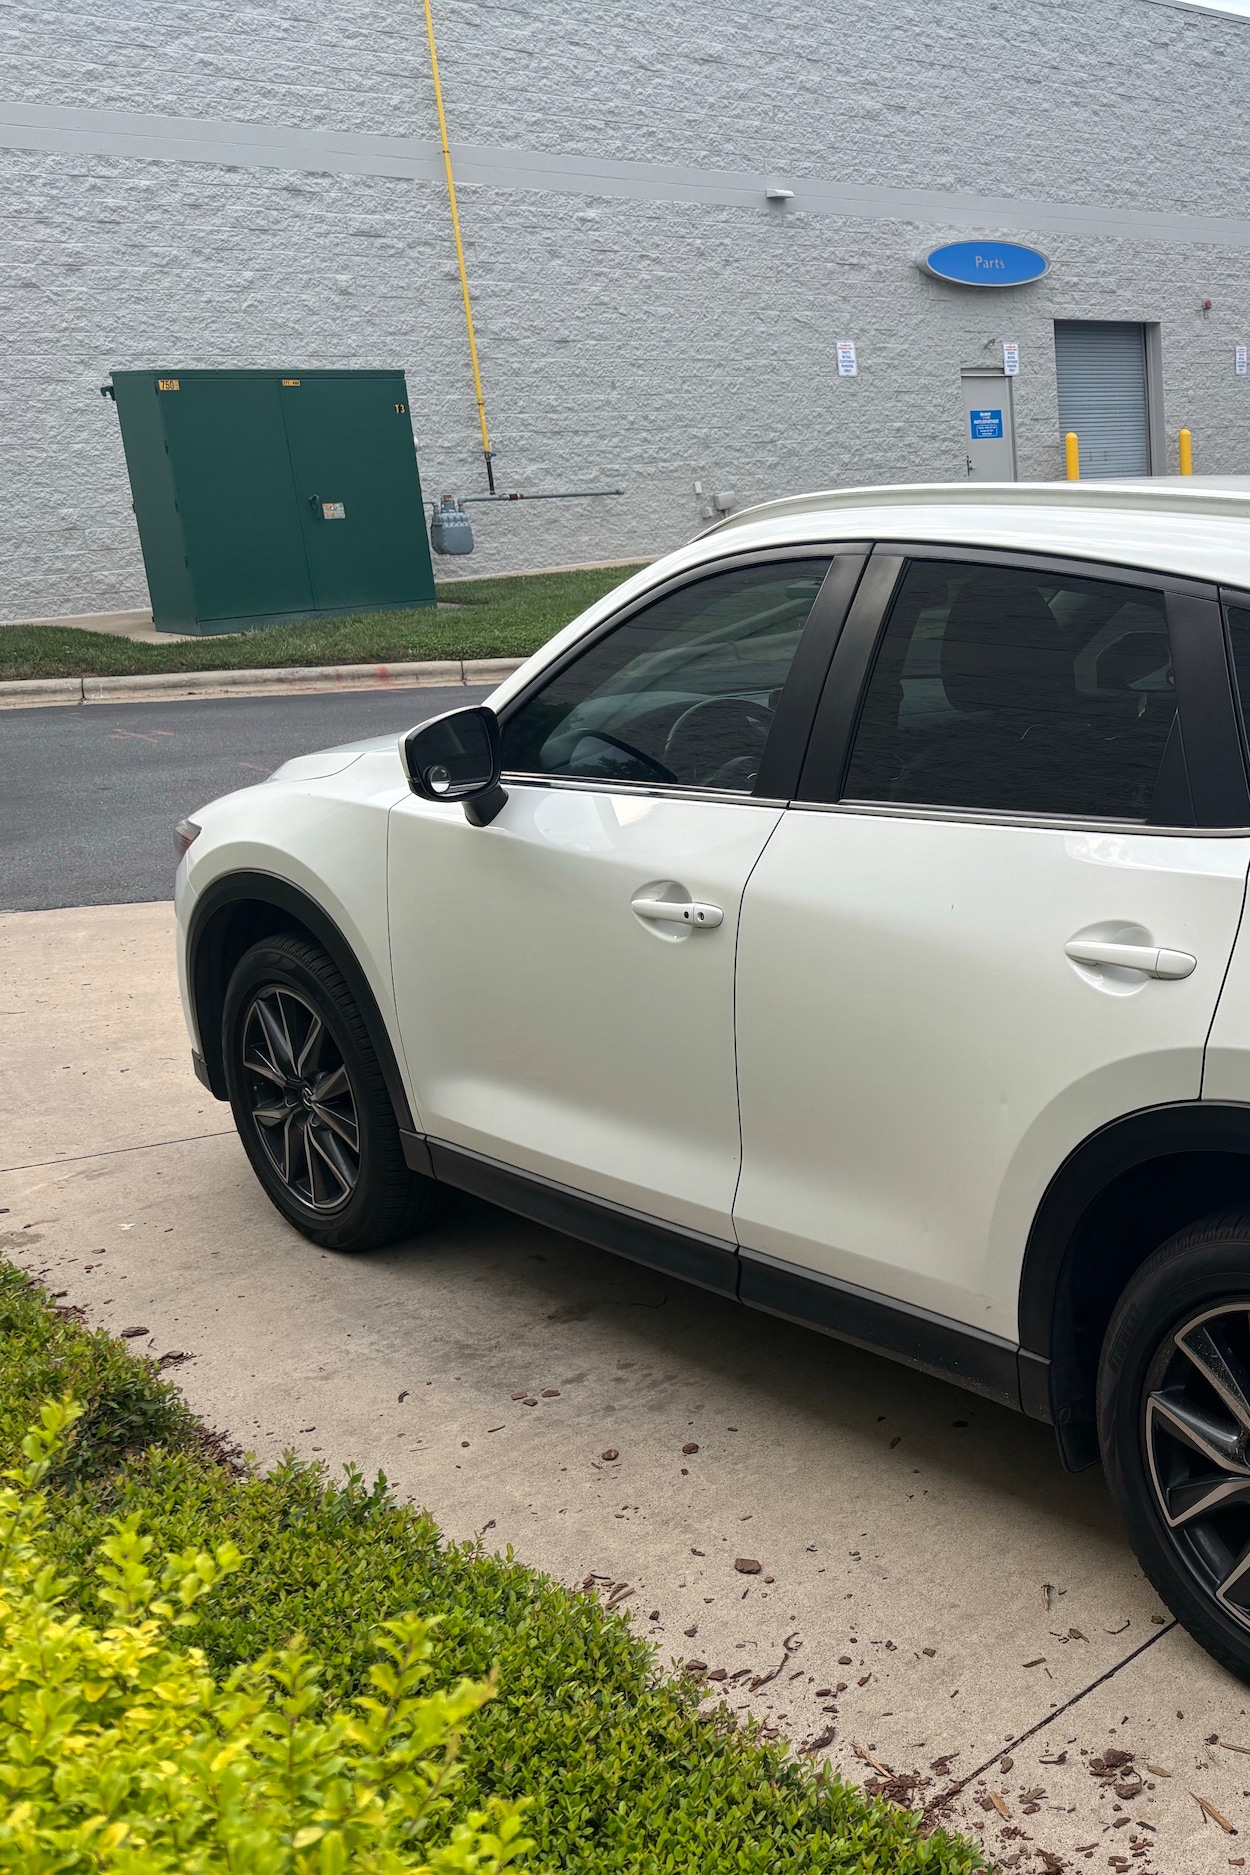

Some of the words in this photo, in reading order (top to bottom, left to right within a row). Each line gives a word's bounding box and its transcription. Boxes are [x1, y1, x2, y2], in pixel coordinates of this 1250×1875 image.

[975, 255, 1005, 269] Parts
[160, 380, 175, 390] 750
[394, 404, 406, 414] T3
